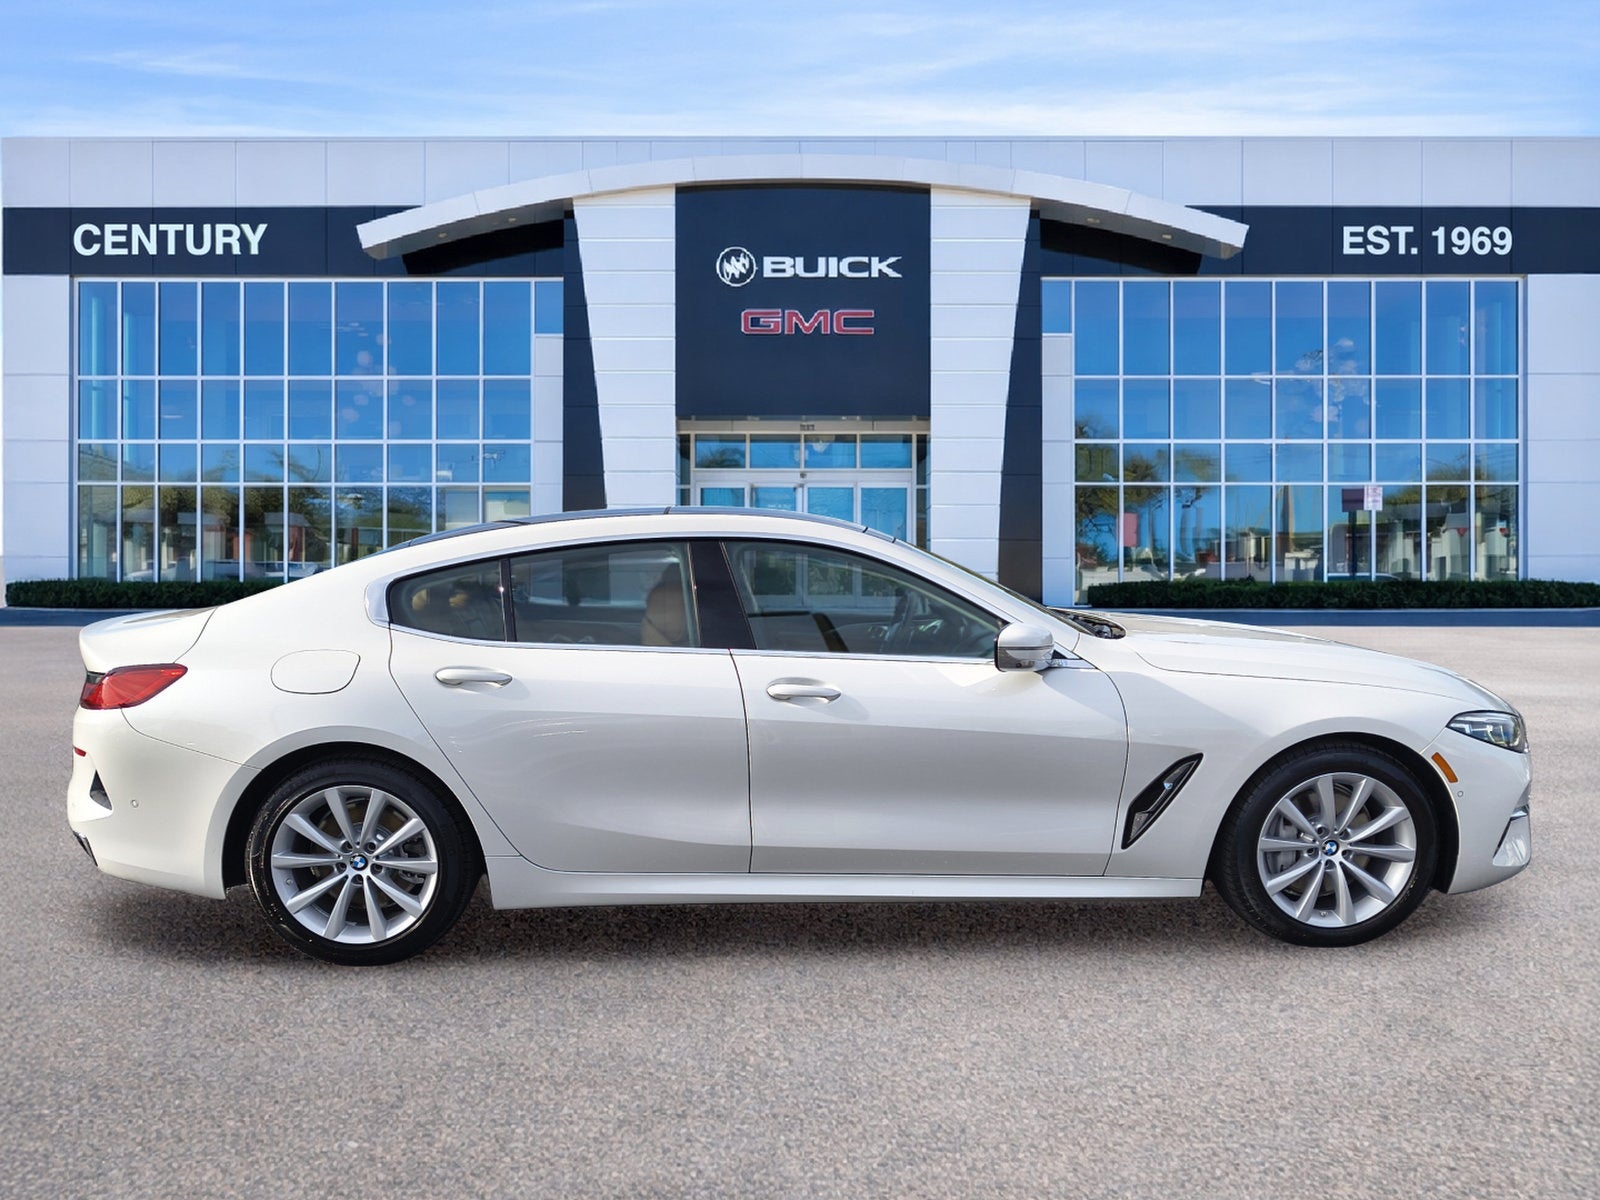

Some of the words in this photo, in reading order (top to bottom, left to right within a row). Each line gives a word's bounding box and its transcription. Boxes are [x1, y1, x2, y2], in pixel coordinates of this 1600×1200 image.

[73, 223, 268, 257] CENTURY
[1342, 225, 1418, 256] EST.
[1431, 226, 1513, 256] 1969
[762, 256, 903, 278] BUICK
[740, 308, 875, 335] GMC
